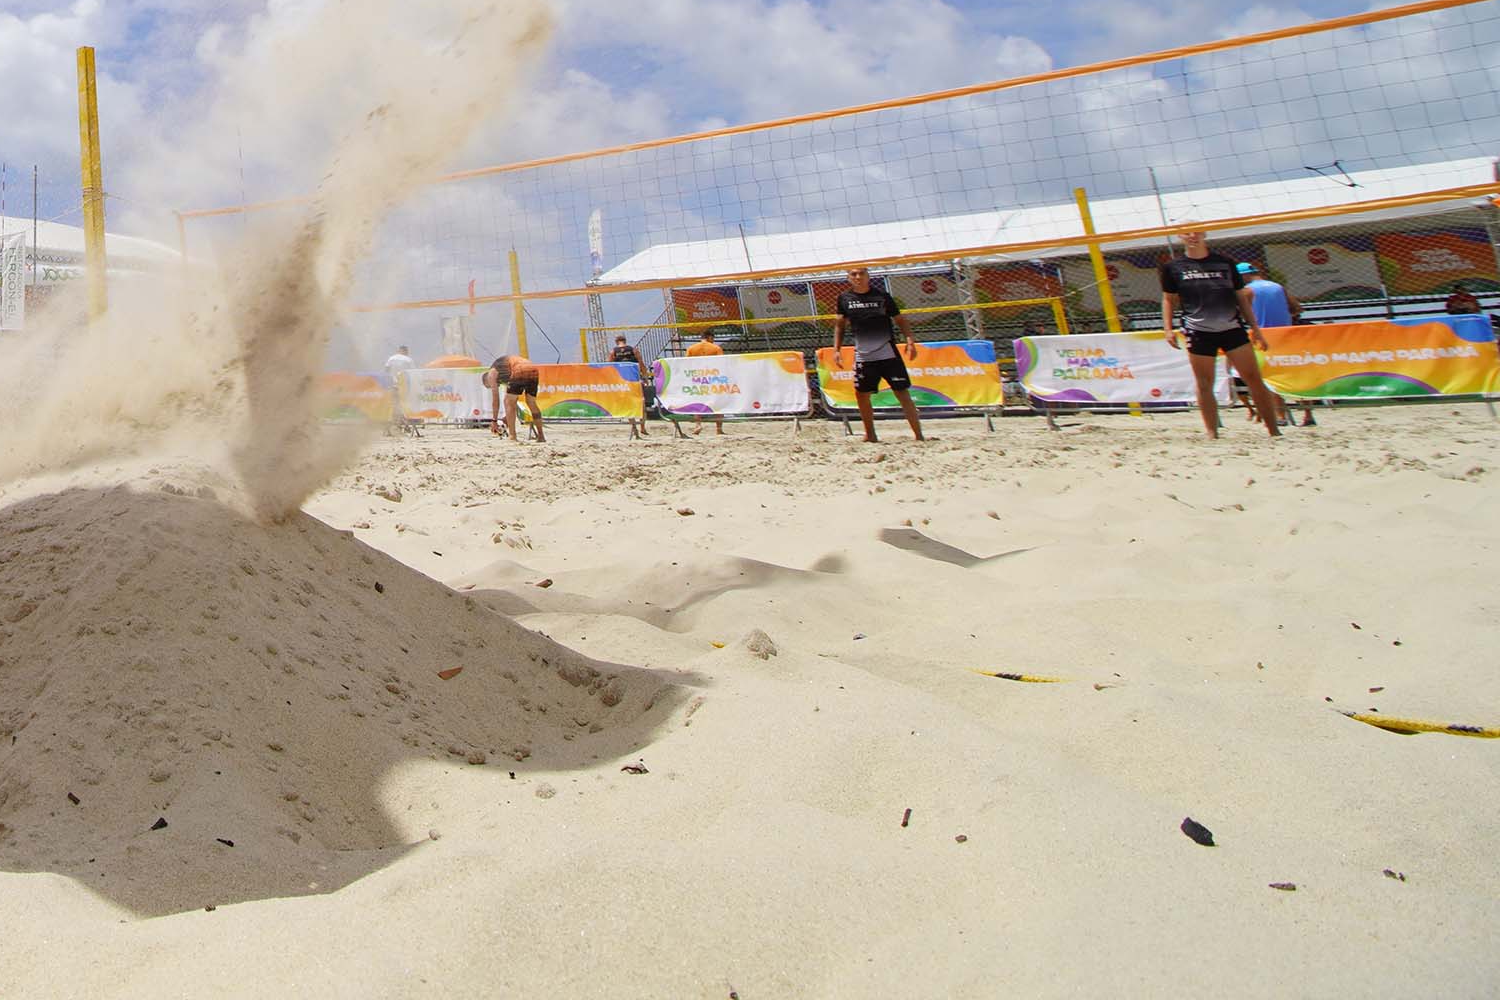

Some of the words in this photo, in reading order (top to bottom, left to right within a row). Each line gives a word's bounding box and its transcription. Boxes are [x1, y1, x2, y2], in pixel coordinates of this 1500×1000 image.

[1067, 357, 1119, 368] MAIOR
[1266, 351, 1330, 367] VERÃO
[1332, 350, 1393, 364] MAIOR
[1396, 345, 1479, 361] PARANÁ
[1052, 365, 1135, 380] PARANÁ
